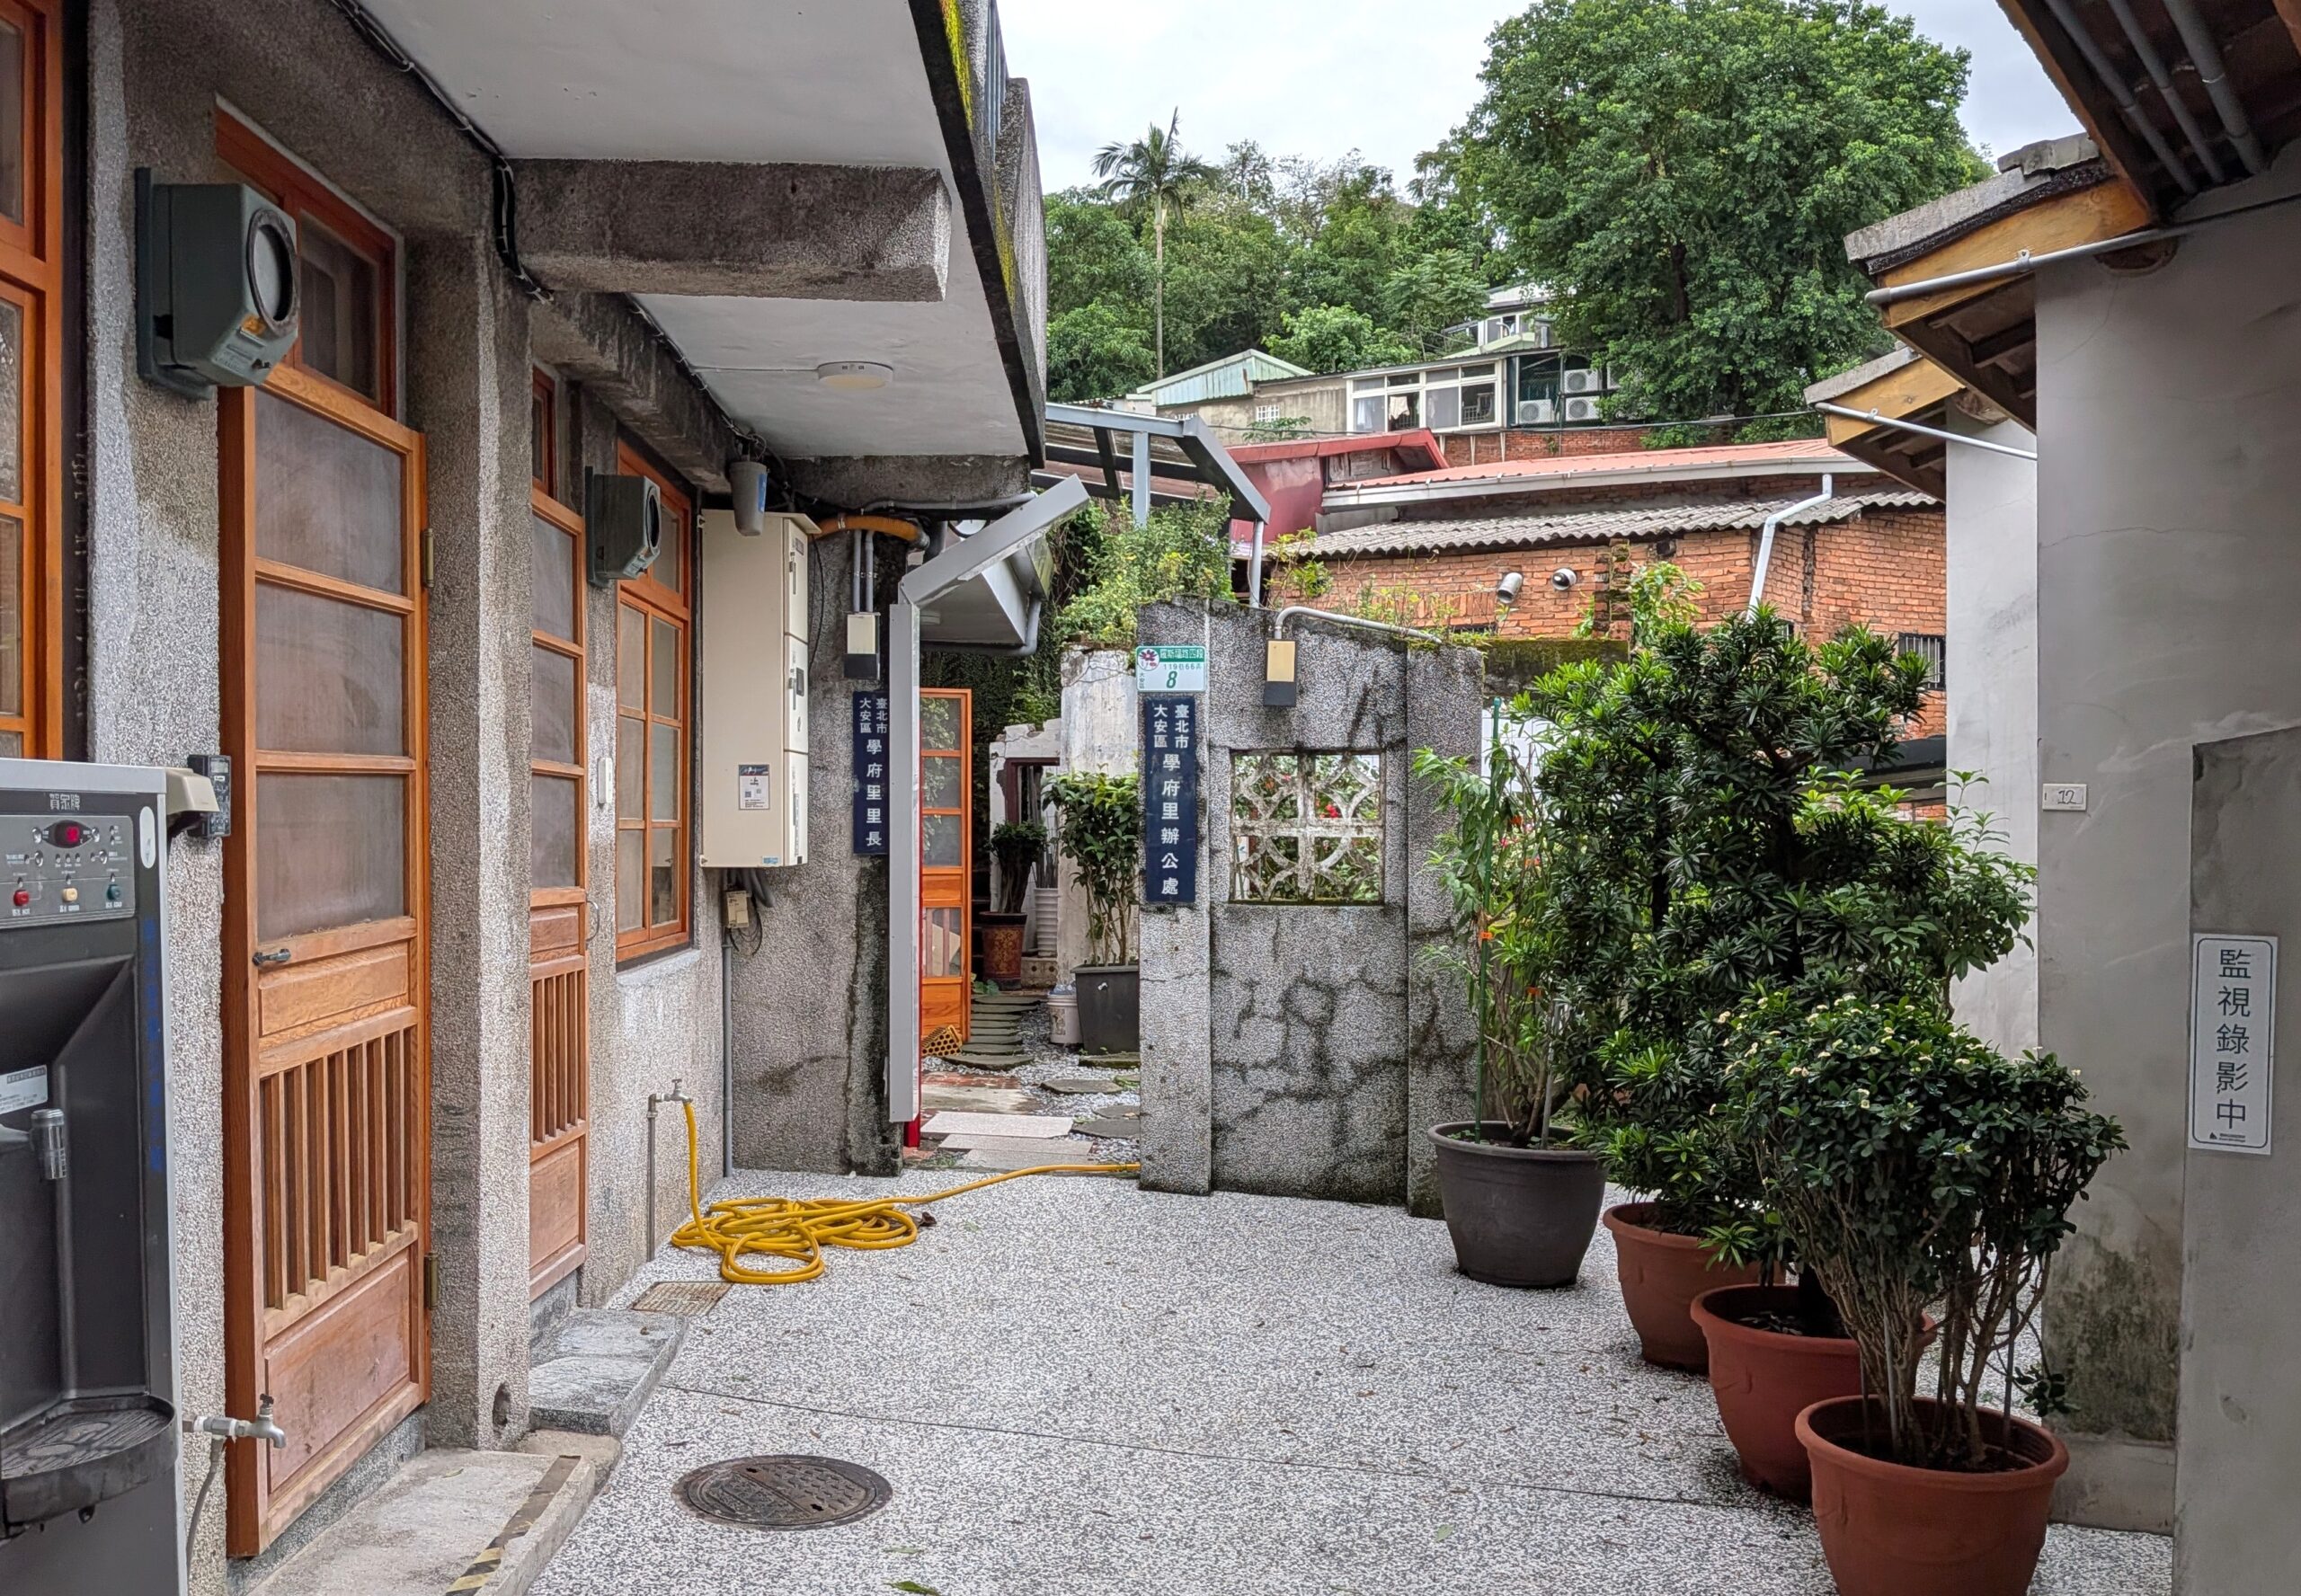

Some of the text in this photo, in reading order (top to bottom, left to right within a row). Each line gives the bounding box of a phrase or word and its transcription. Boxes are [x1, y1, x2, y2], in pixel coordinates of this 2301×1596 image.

[1159, 648, 1204, 659] 羅斯福路四段
[1166, 670, 1177, 688] 8
[859, 697, 872, 734] 大安區
[875, 697, 888, 734] 臺北市
[1153, 704, 1168, 749] 大安區
[1175, 704, 1190, 749] 臺北市
[866, 739, 883, 847] 學府里里長
[1160, 753, 1181, 895] 學府里辦公處
[2216, 949, 2252, 1130] 監視錄影中
